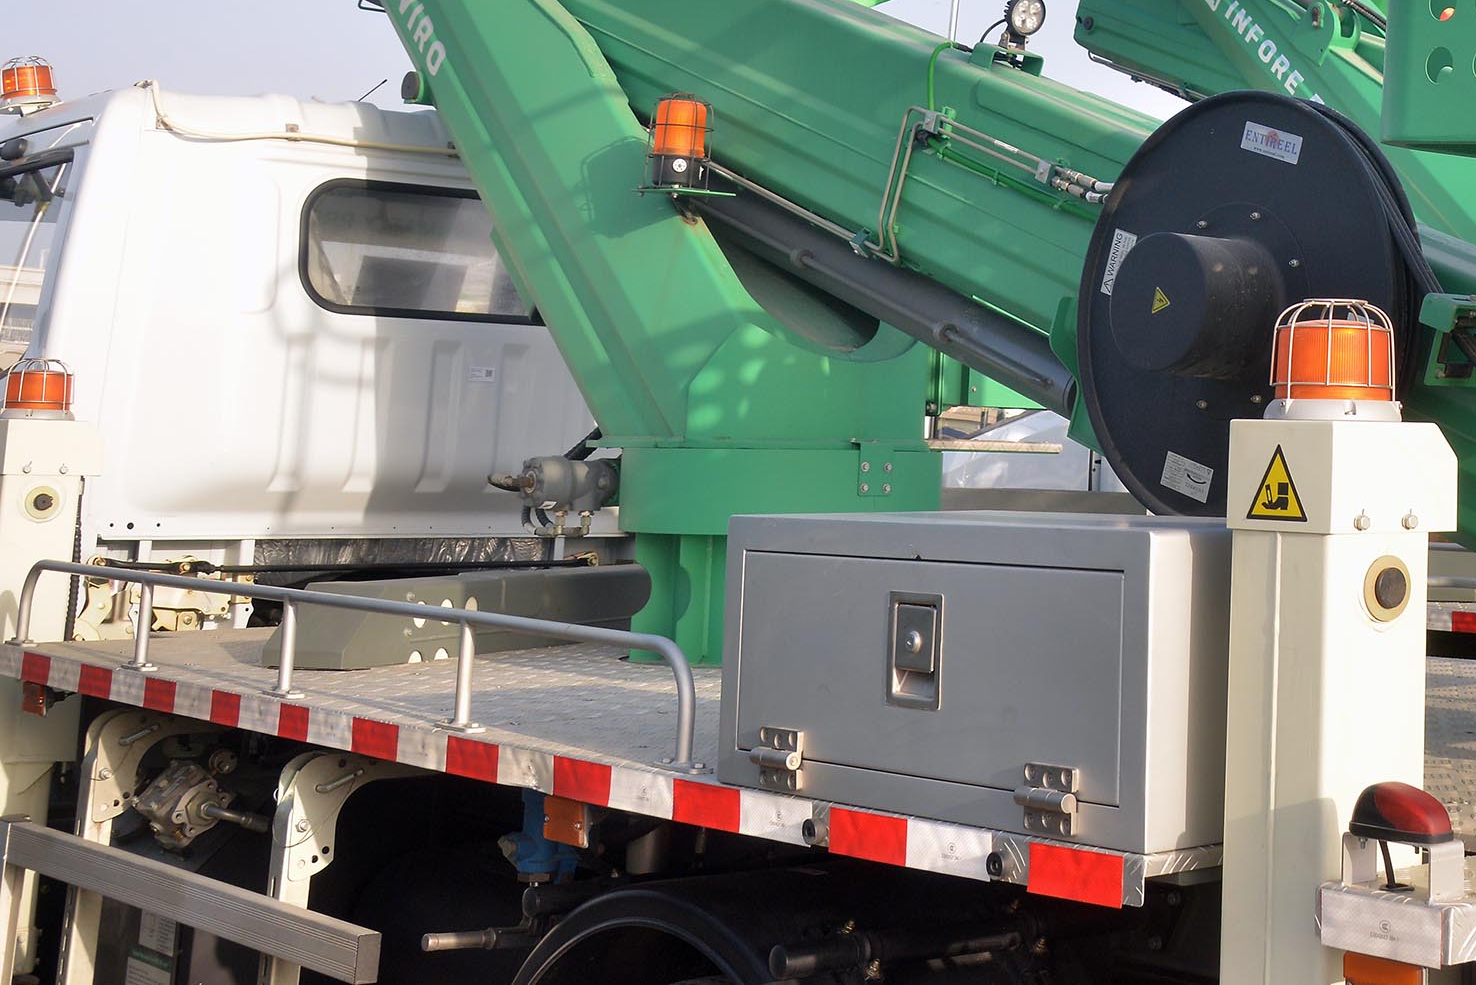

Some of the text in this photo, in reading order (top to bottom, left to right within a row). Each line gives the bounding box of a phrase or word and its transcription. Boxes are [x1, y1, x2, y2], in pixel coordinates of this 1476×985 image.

[1224, 0, 1305, 96] INFORE
[1244, 129, 1297, 155] ENTIREEL
[1106, 233, 1123, 276] WARNING
